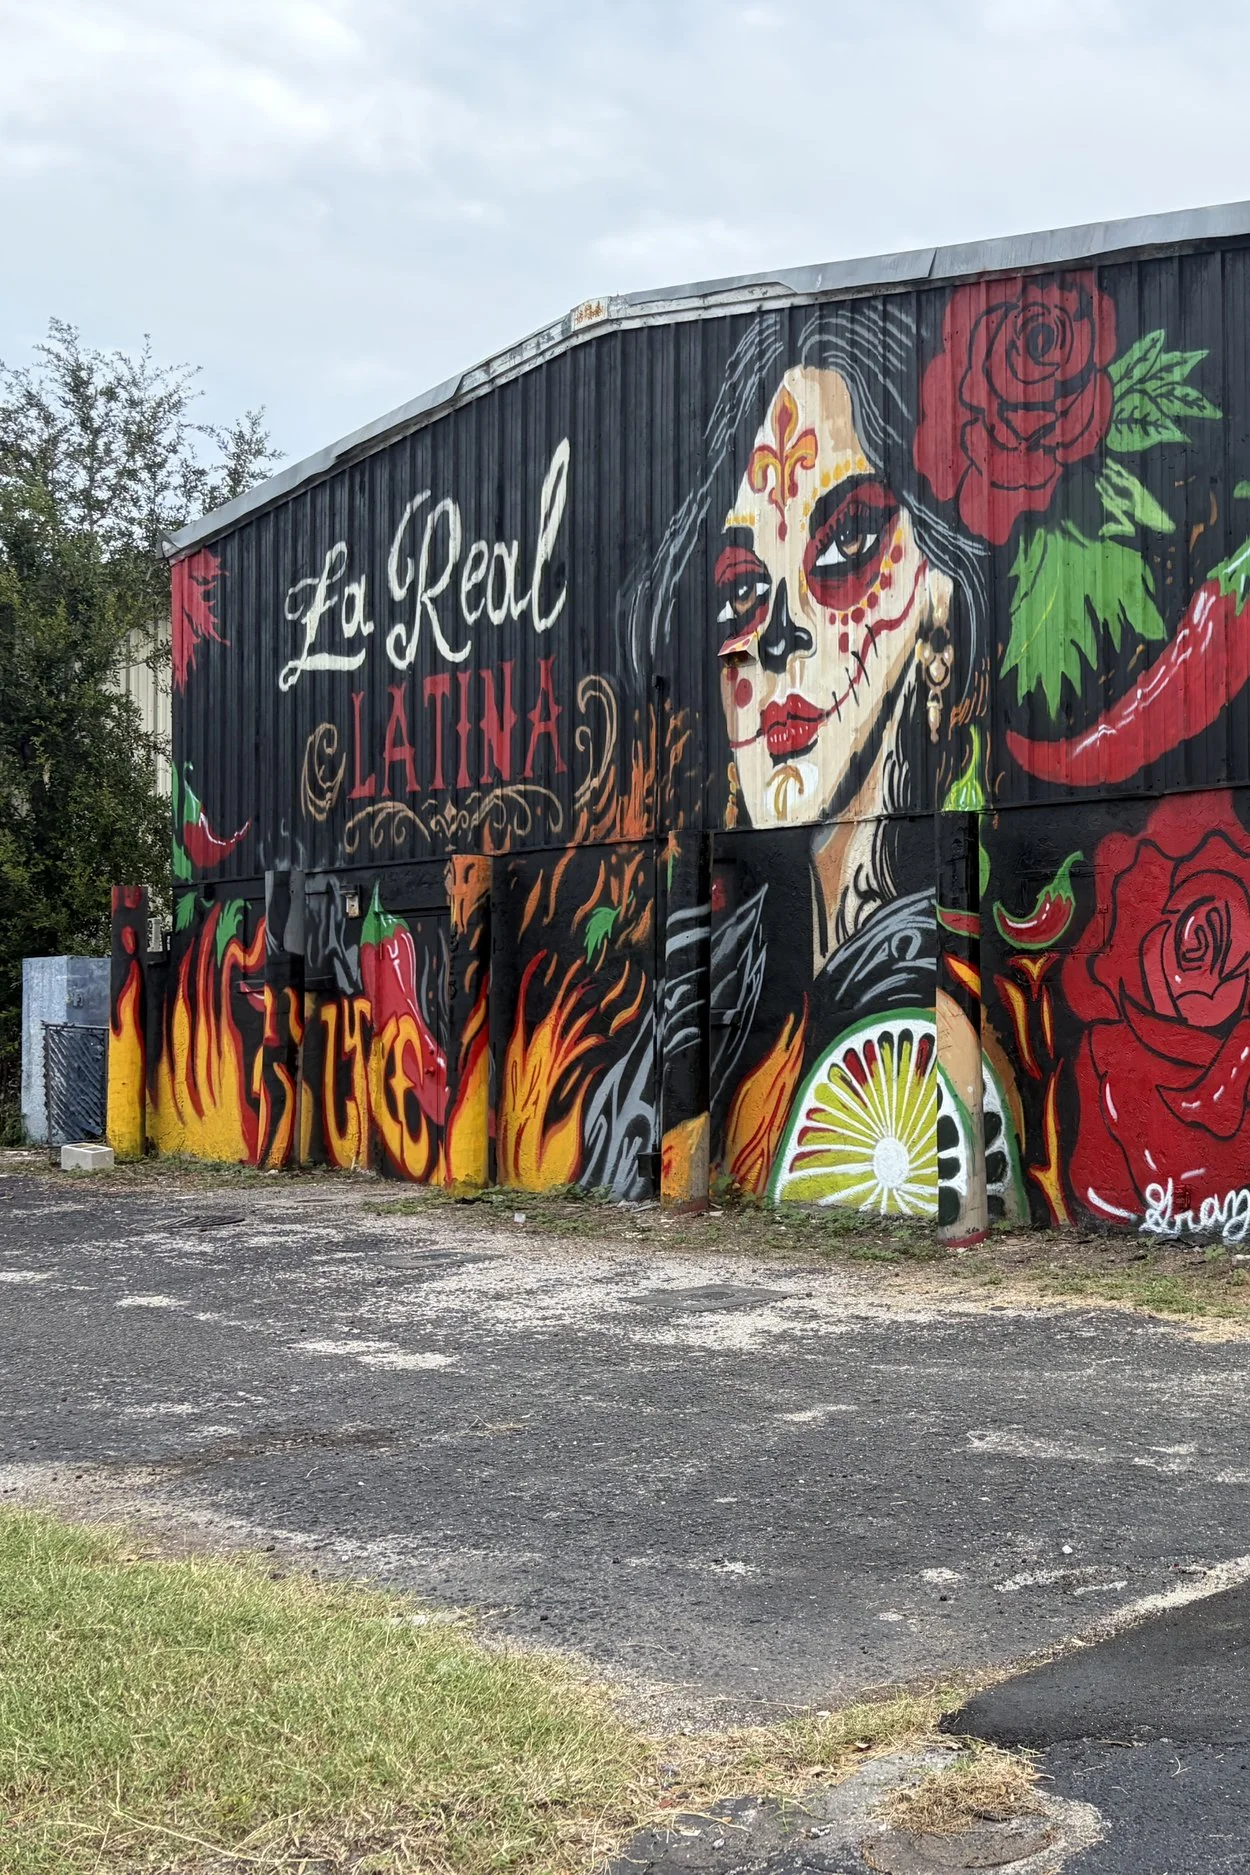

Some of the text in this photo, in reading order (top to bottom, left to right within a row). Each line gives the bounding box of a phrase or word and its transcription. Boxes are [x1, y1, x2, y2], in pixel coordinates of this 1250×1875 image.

[278, 437, 571, 692] La Real
[347, 653, 568, 801] LATINA
